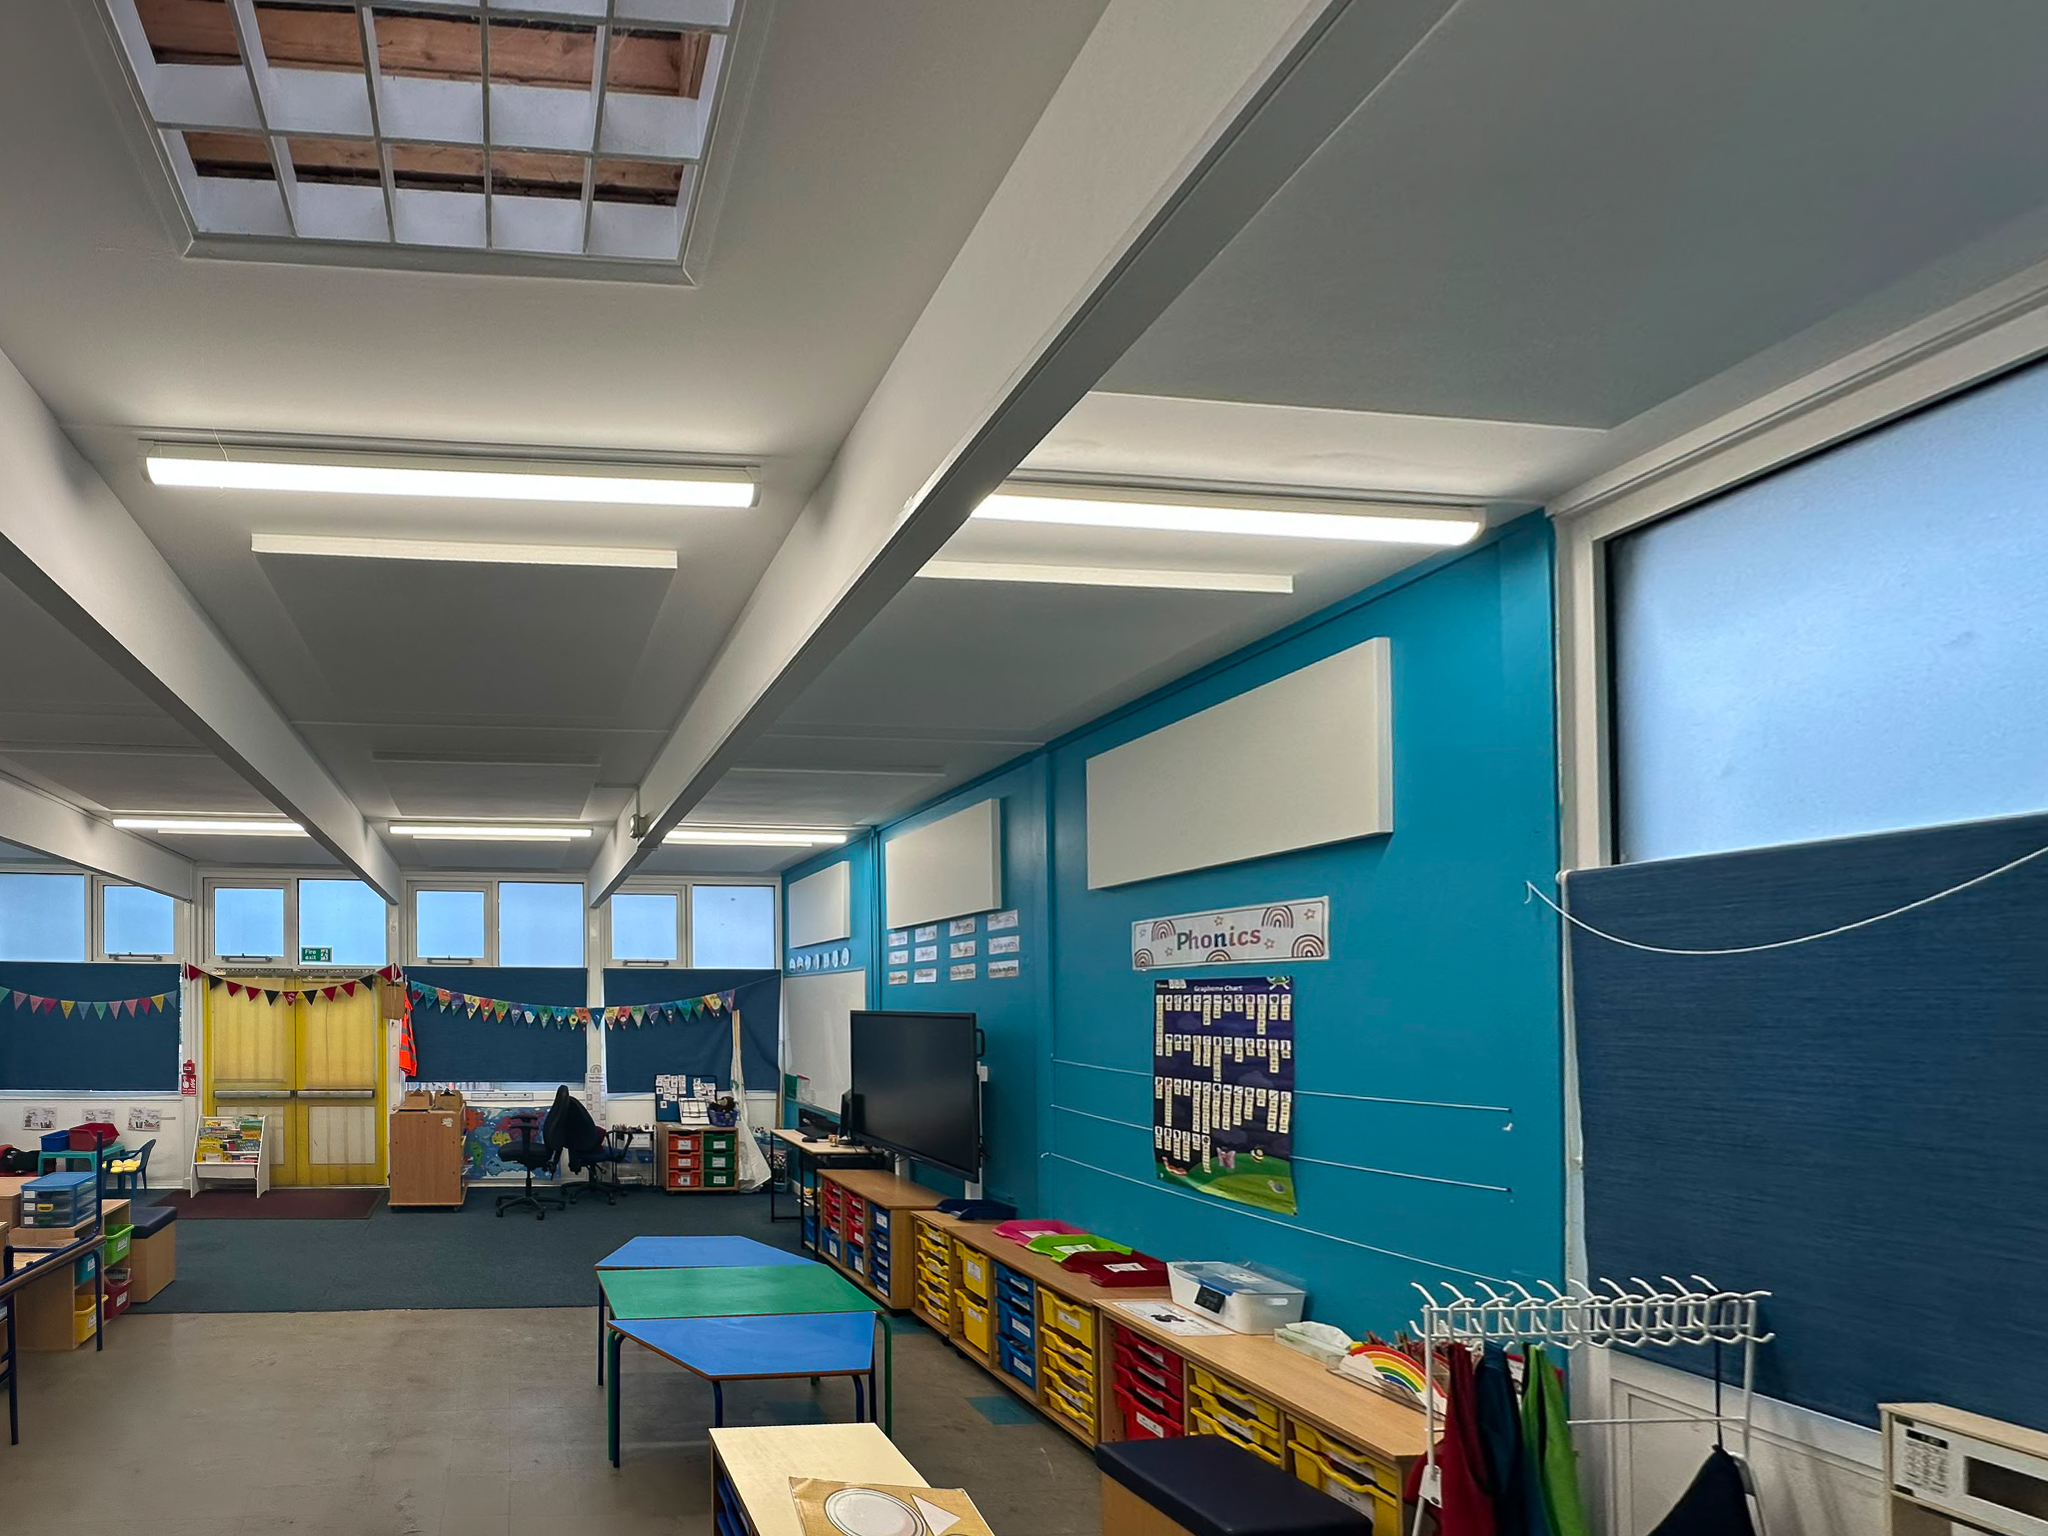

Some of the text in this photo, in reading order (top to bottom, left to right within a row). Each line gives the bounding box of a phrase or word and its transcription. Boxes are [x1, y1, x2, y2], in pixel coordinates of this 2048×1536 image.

[1176, 926, 1262, 951] Phonics
[1193, 985, 1224, 993] Grapheme
[1224, 984, 1243, 992] Chart
